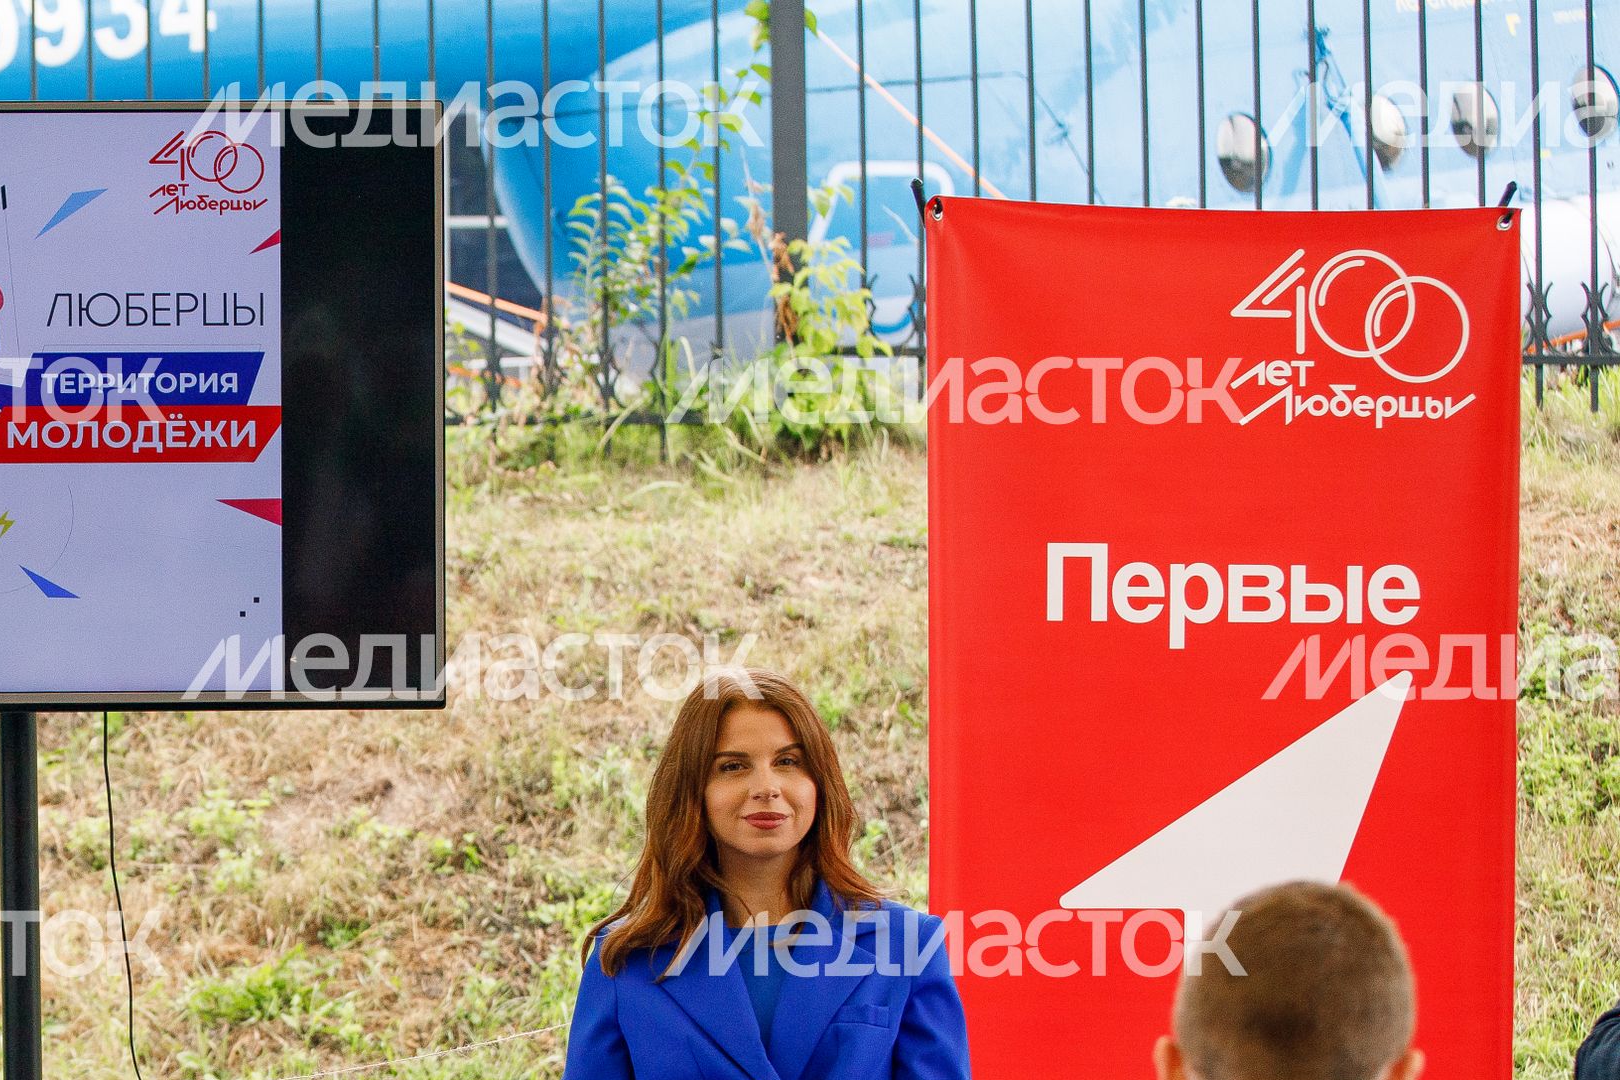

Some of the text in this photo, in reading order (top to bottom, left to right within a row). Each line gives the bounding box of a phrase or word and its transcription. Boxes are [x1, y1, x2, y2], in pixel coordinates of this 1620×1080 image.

[148, 130, 265, 194] 400
[153, 195, 268, 215] Люберцы
[46, 292, 265, 327] ЛЮБЕРЦЫ
[1230, 248, 1470, 383] 400
[41, 372, 239, 394] ТЕРРИТОРИЯ
[1238, 384, 1476, 429] Люберцы
[7, 413, 256, 453] МОЛОДЁЖИ
[1046, 542, 1421, 649] Первые
